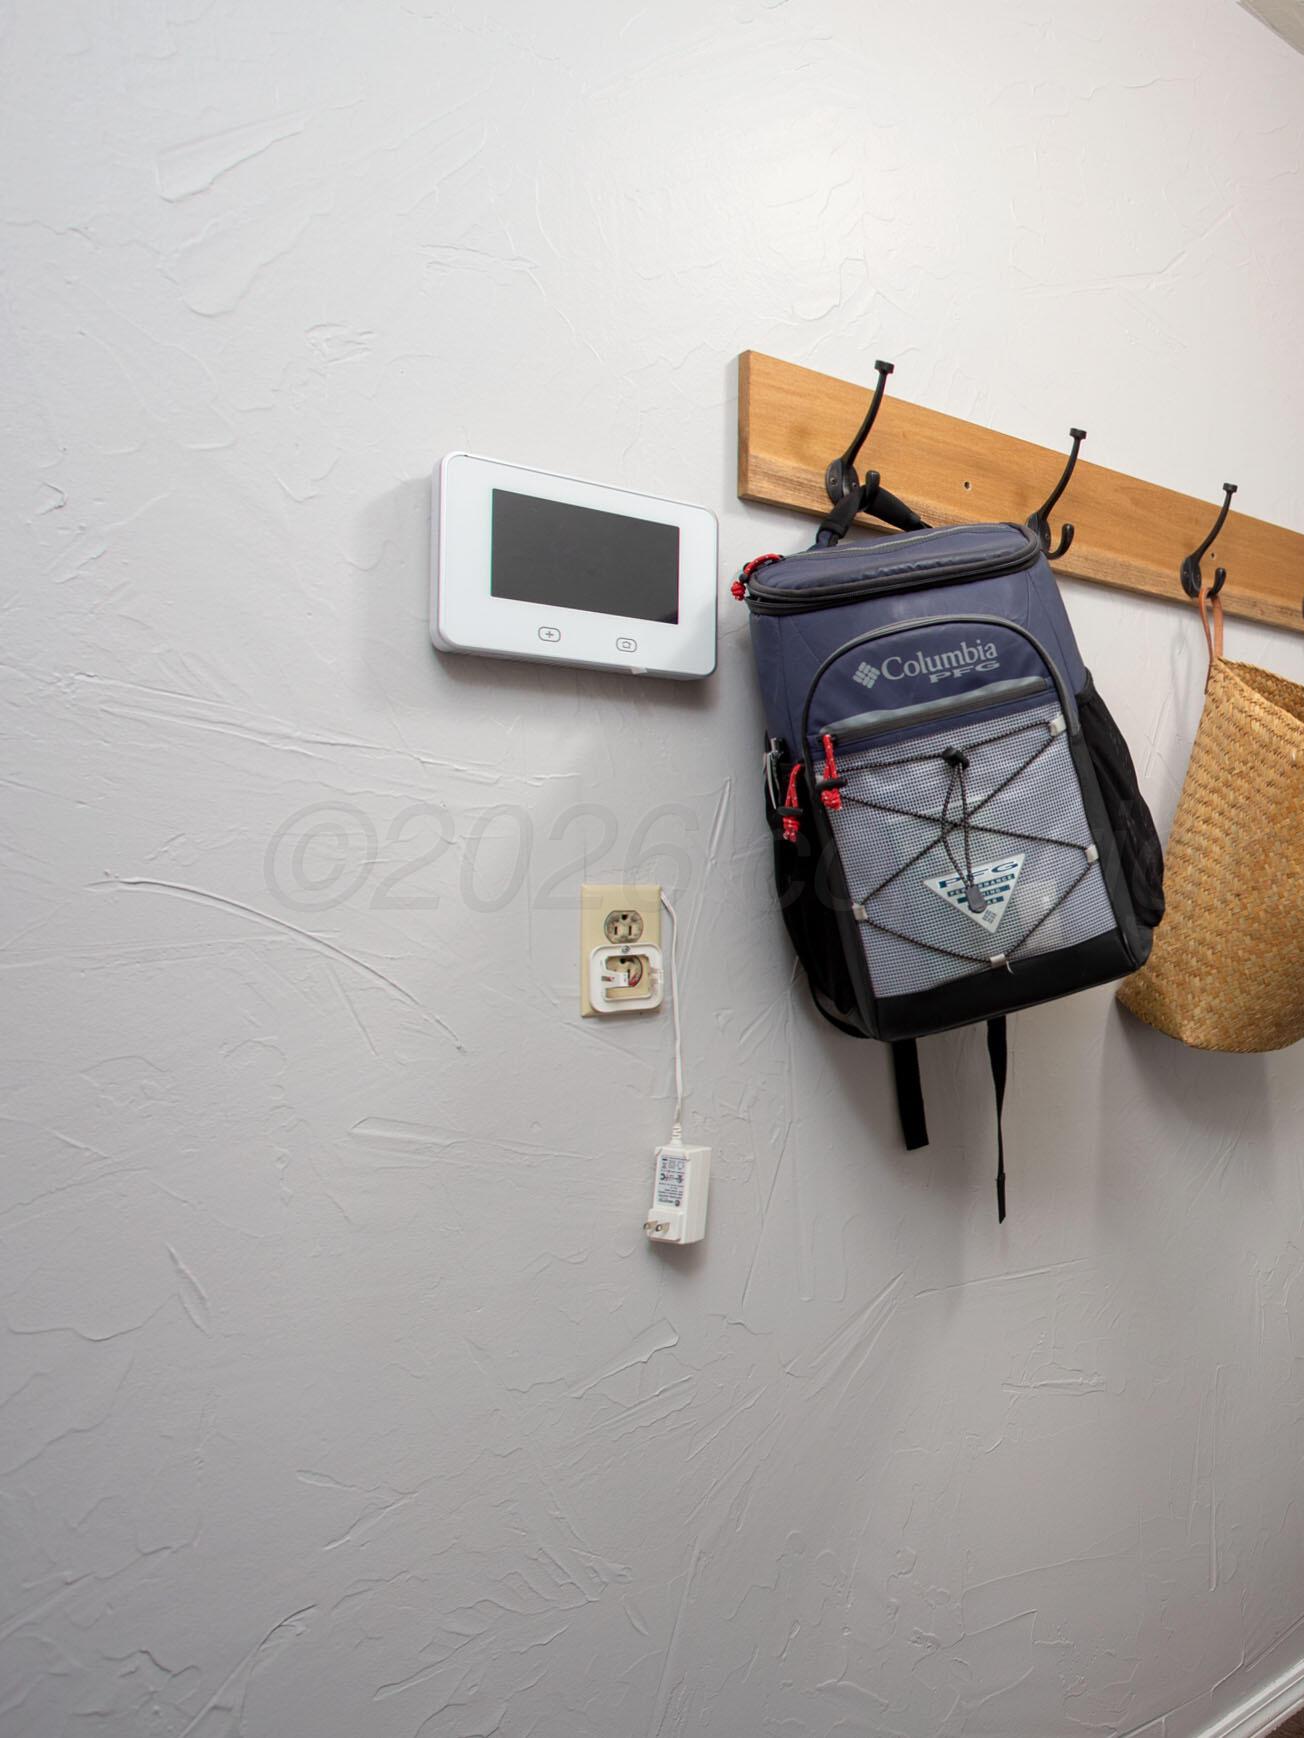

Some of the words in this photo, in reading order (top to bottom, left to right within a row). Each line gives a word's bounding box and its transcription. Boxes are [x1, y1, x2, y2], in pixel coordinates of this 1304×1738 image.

[881, 639, 998, 682] Columbia
[929, 659, 1001, 684] PFG
[939, 861, 1018, 888] PFG
